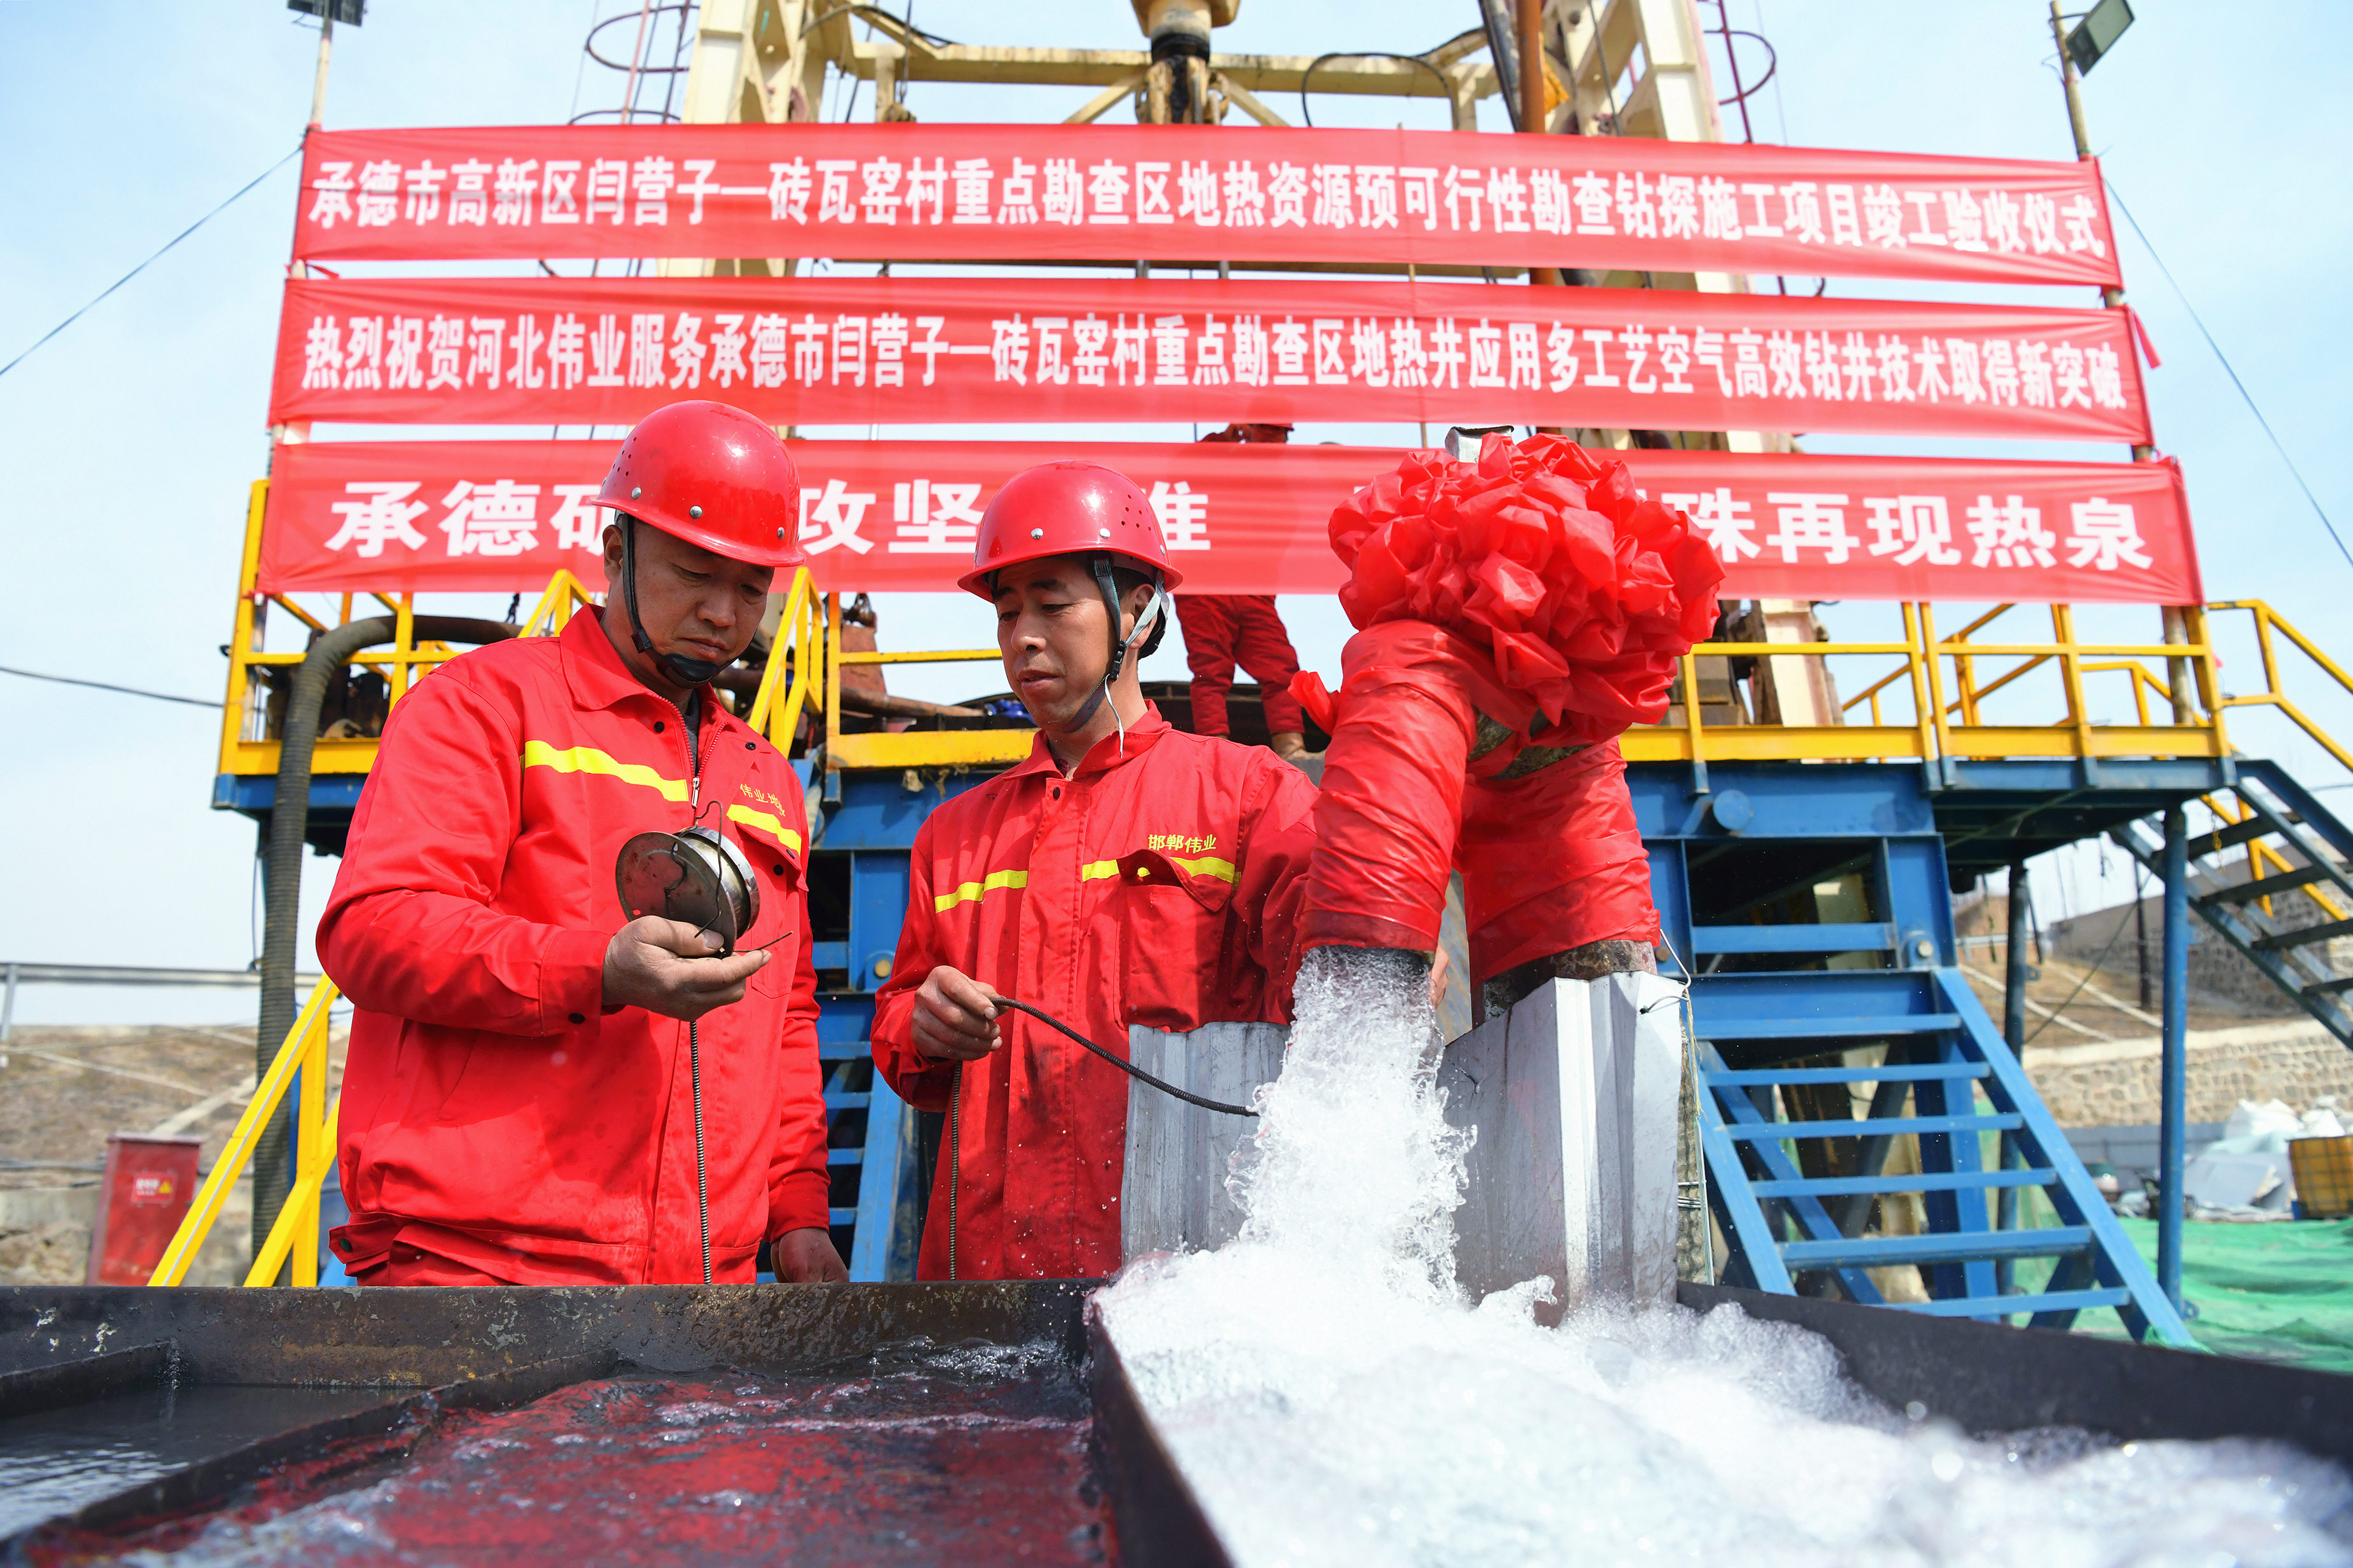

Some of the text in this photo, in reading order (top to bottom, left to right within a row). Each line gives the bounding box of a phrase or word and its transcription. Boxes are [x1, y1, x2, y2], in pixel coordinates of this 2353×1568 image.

[1635, 486, 2154, 572] 珠再现热泉
[1148, 834, 1217, 854] 邯郸伟业
